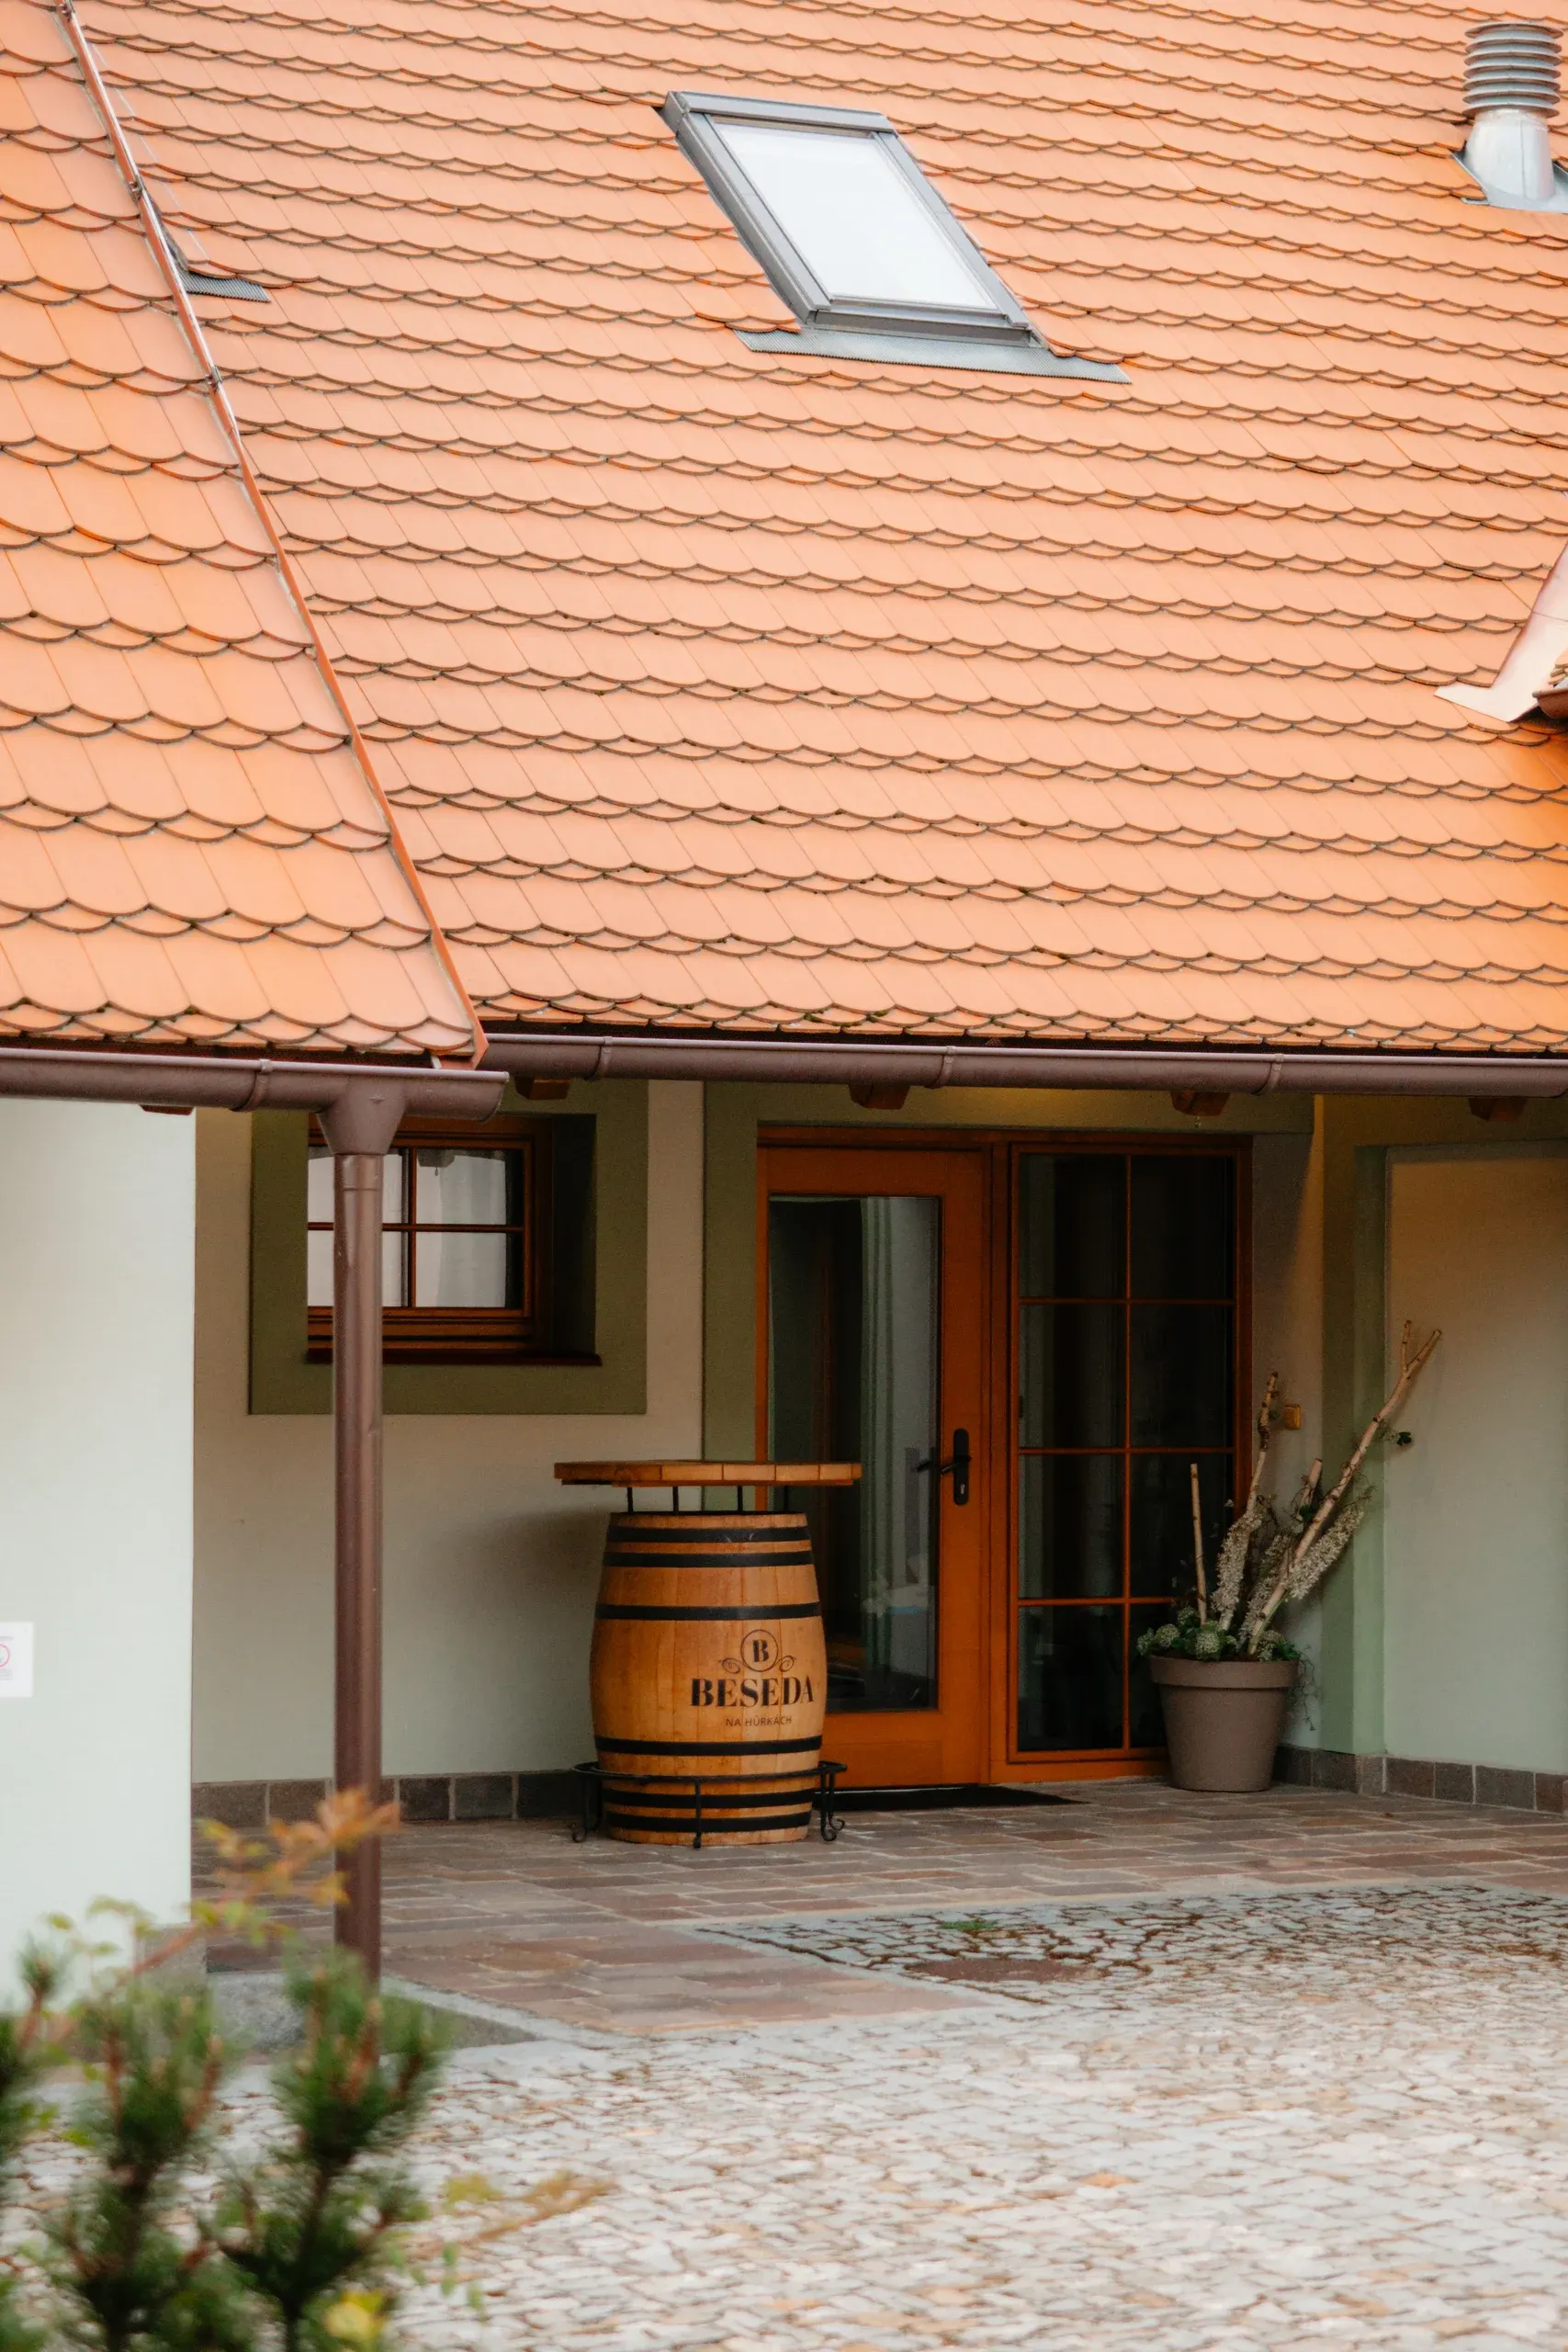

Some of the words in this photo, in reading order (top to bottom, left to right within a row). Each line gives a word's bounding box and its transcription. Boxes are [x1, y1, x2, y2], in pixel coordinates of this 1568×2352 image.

[752, 1639, 770, 1663] B
[691, 1676, 815, 1708] BESEDA
[725, 1717, 741, 1727] NA
